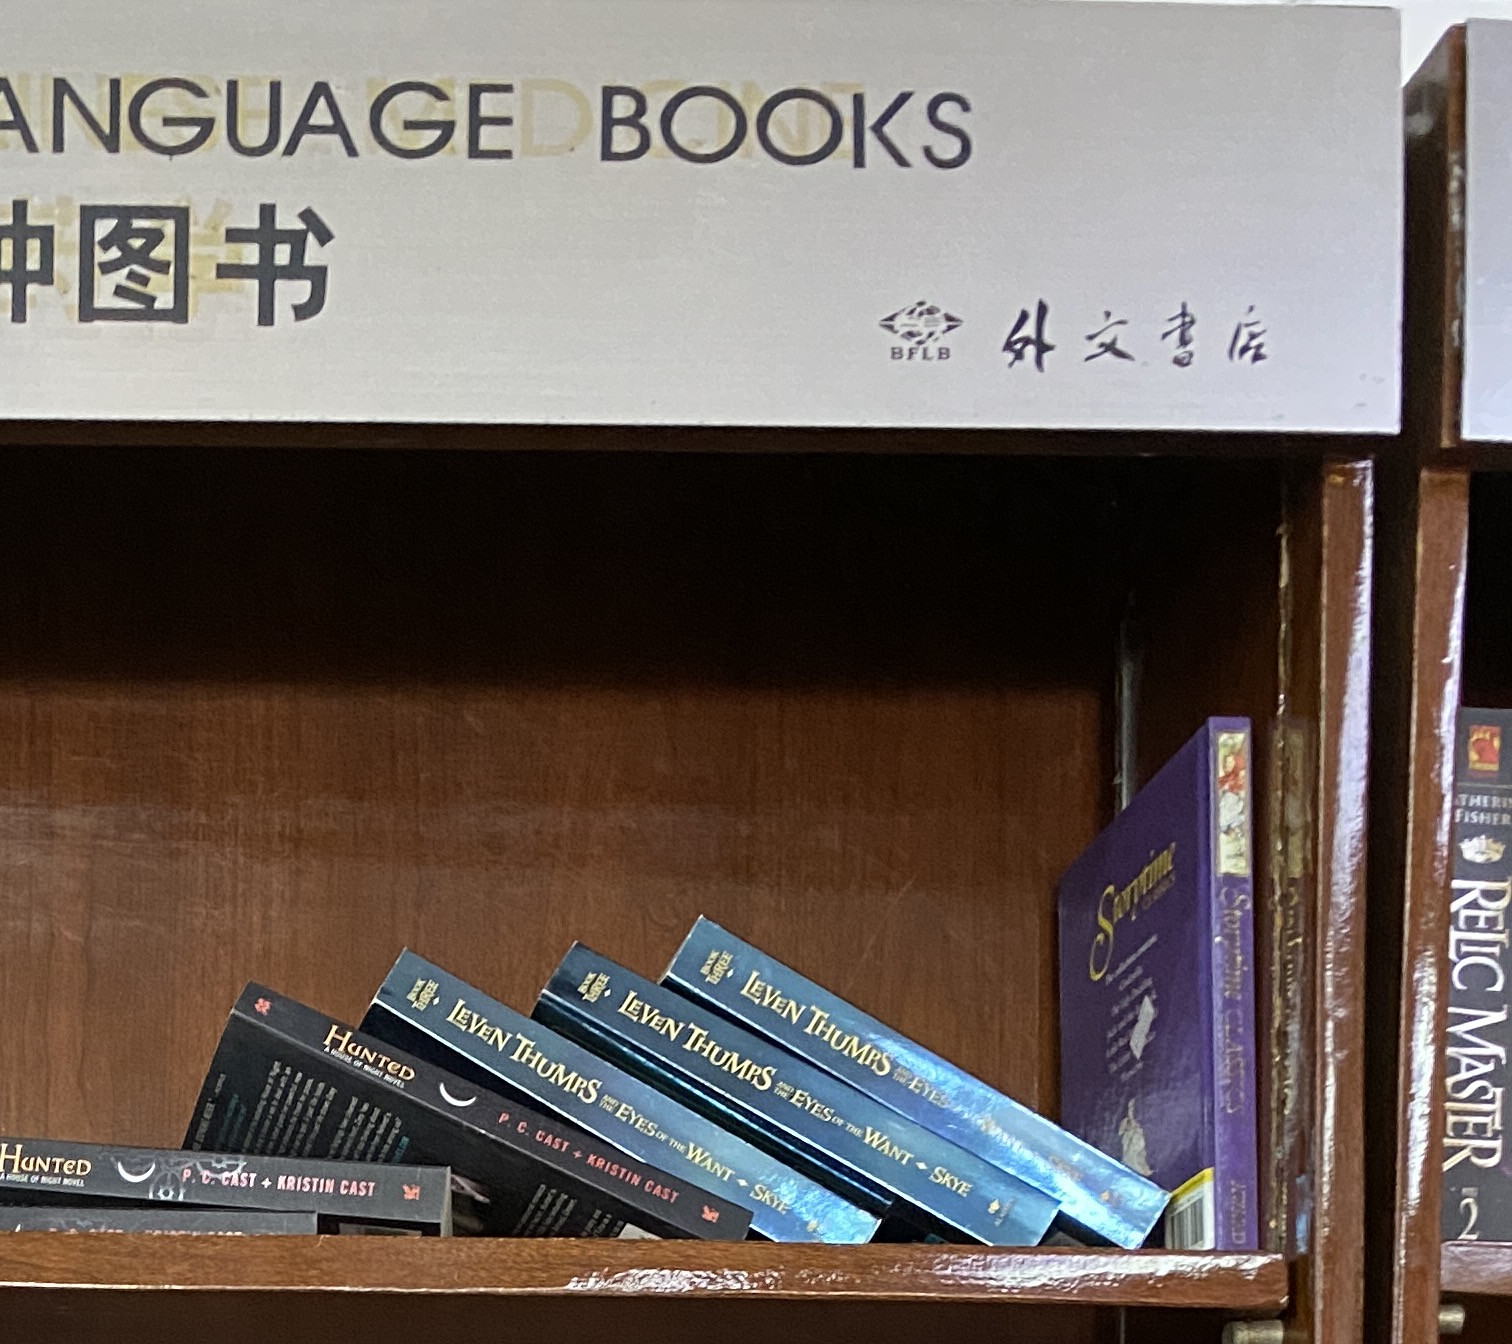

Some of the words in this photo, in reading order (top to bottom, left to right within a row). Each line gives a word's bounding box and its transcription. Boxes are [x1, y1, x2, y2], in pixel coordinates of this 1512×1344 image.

[599, 84, 973, 169] BOOKS
[890, 347, 951, 361] BFLB
[1449, 878, 1511, 993] RELIC
[618, 990, 684, 1042] LEVEN
[681, 1019, 777, 1091] THUMPS
[741, 970, 802, 1025] LEVEN
[802, 998, 892, 1078] THUMPS
[446, 999, 512, 1053] LEVEN
[511, 1033, 602, 1105] THUMPS
[616, 1101, 658, 1138] EYES
[685, 1143, 737, 1185] WANT
[749, 1183, 790, 1214] SKYE
[1442, 1005, 1507, 1174] MASTER
[221, 1171, 255, 1191] CAST
[277, 1175, 335, 1195] KRISTIN
[340, 1177, 375, 1198] CAST
